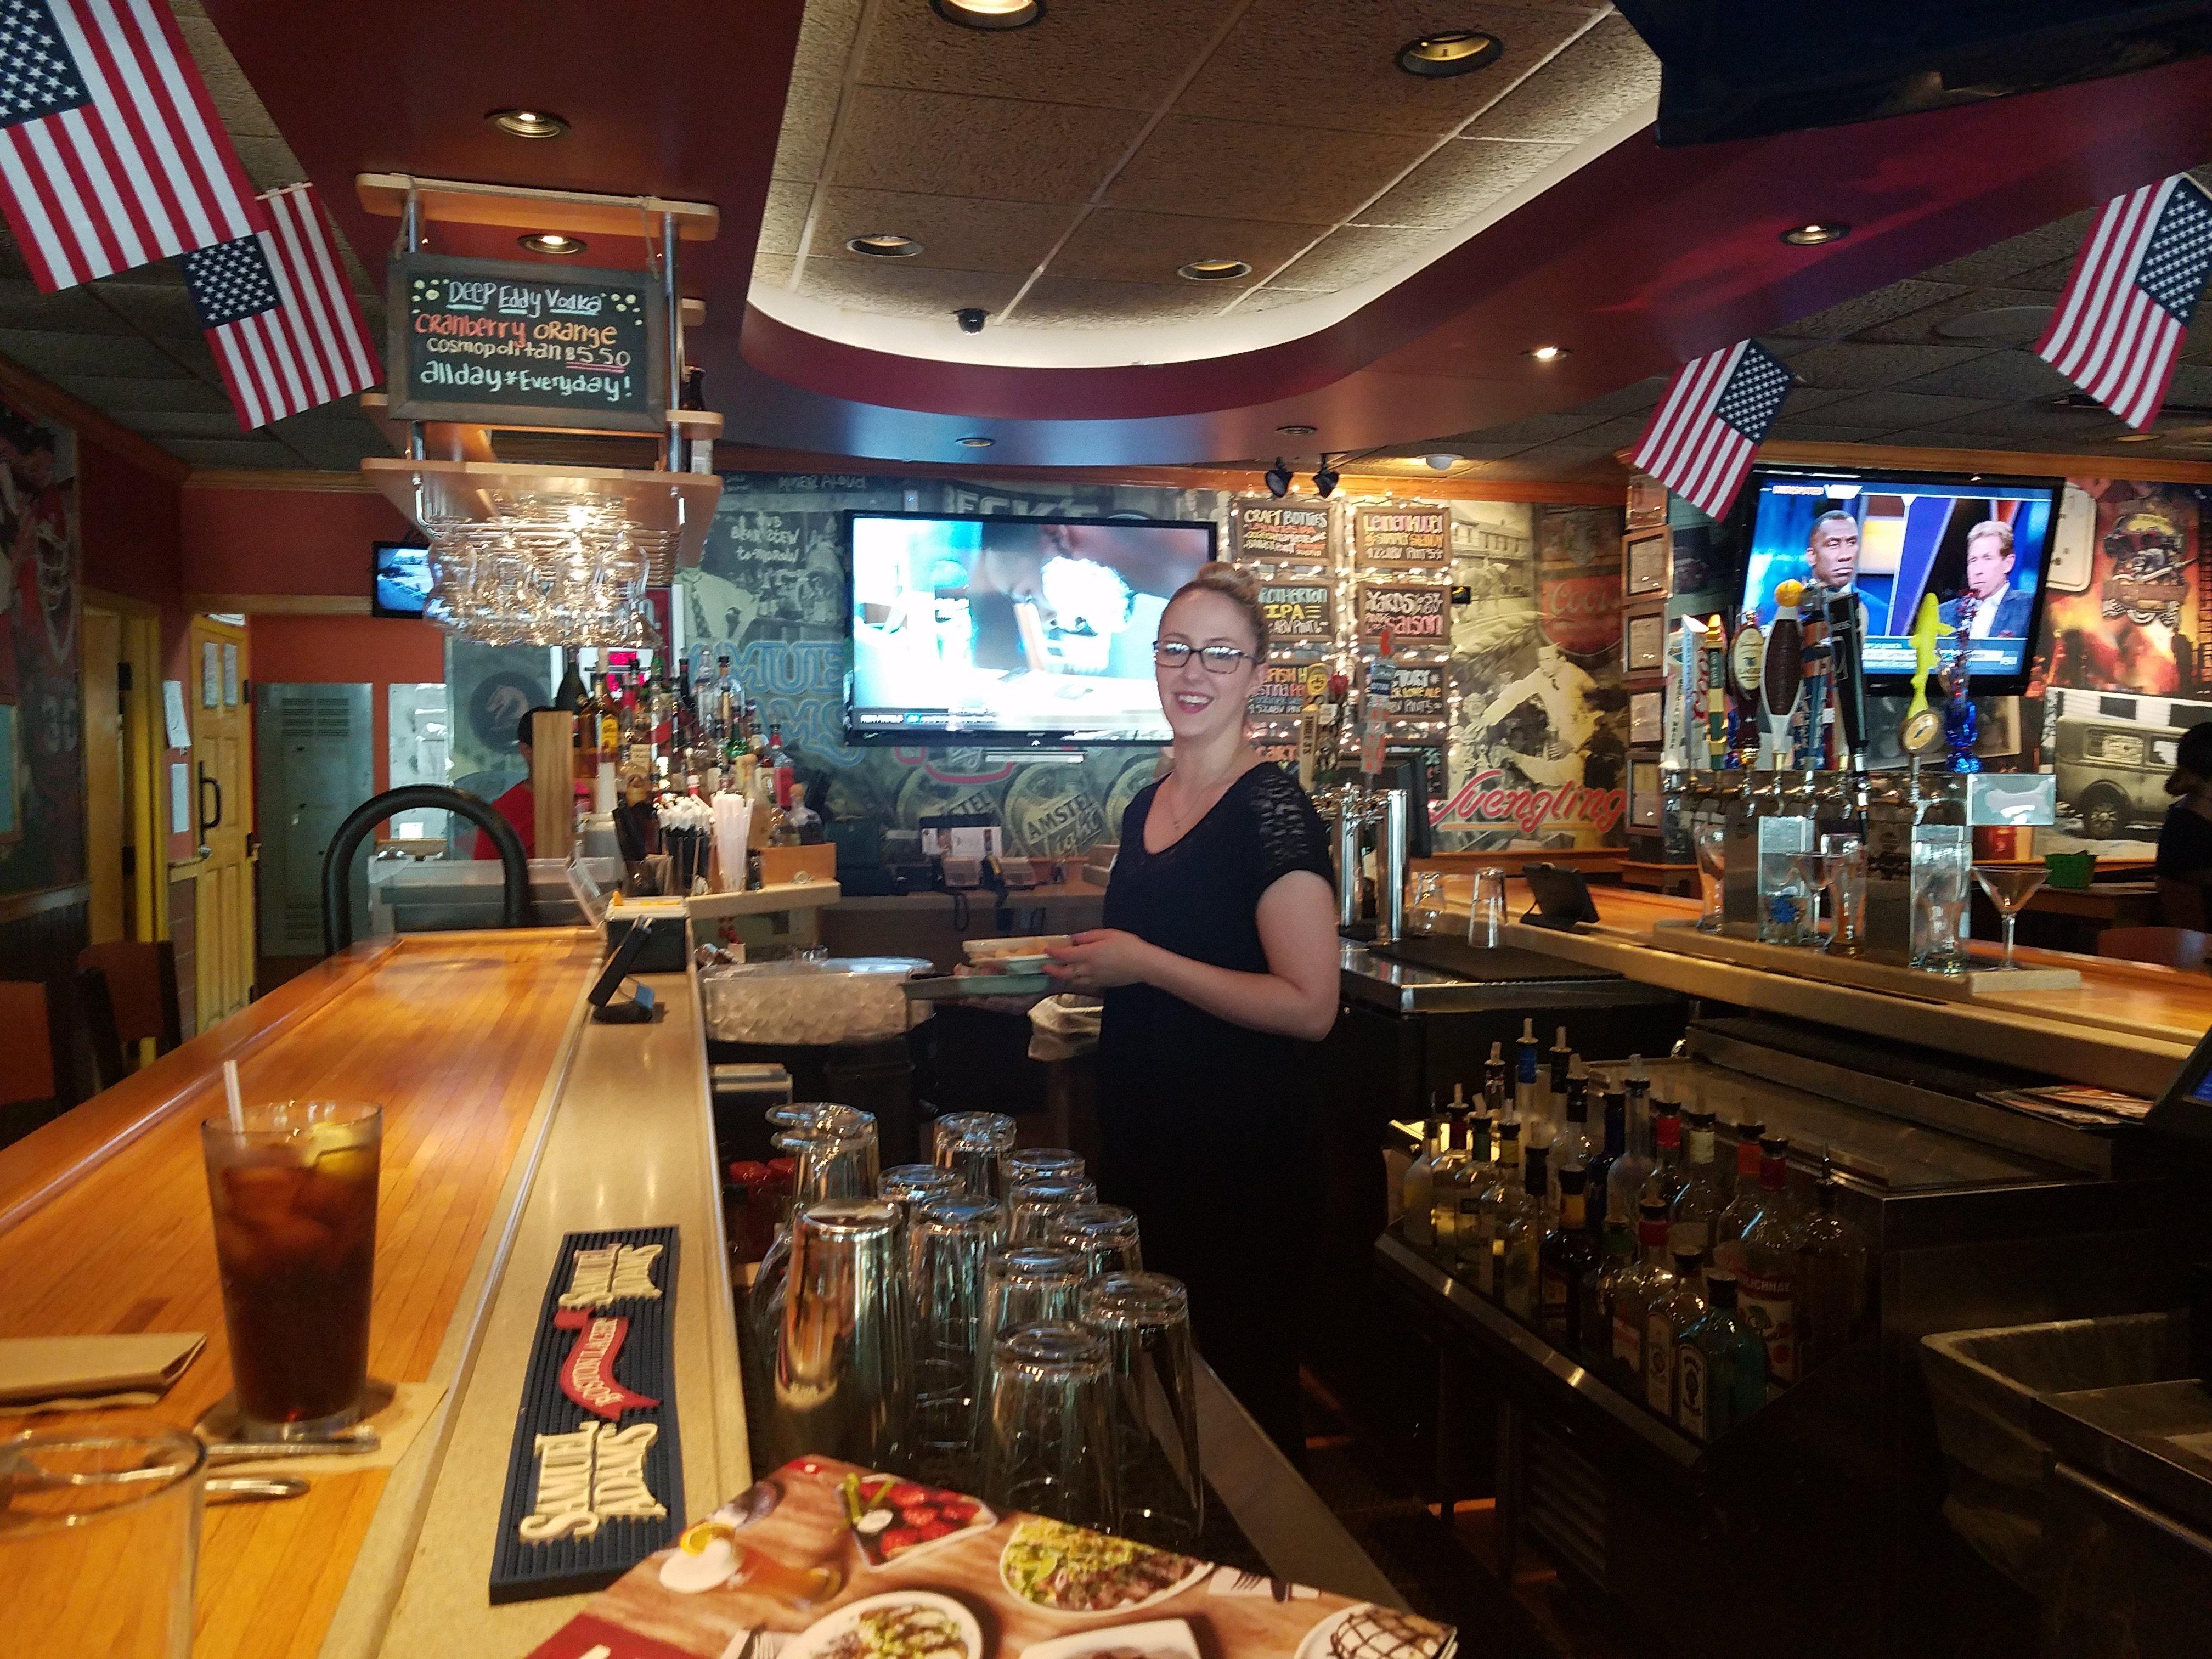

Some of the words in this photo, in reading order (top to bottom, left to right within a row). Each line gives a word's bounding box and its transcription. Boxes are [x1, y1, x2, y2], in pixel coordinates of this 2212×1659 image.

[499, 285, 541, 318] Eddy
[545, 289, 602, 312] Vodka
[1244, 509, 1283, 526] CRAFT
[1263, 604, 1305, 620] IPA
[1027, 789, 1096, 839] AMSTEL
[1429, 769, 1627, 833] Yuengling
[558, 1243, 622, 1308] SAMUEL
[611, 1244, 664, 1301] ADAMS
[584, 1317, 618, 1358] LAGER
[572, 1356, 624, 1406] BOSTON
[519, 1420, 601, 1543] SAMUEL
[594, 1421, 668, 1519] ADAMS
